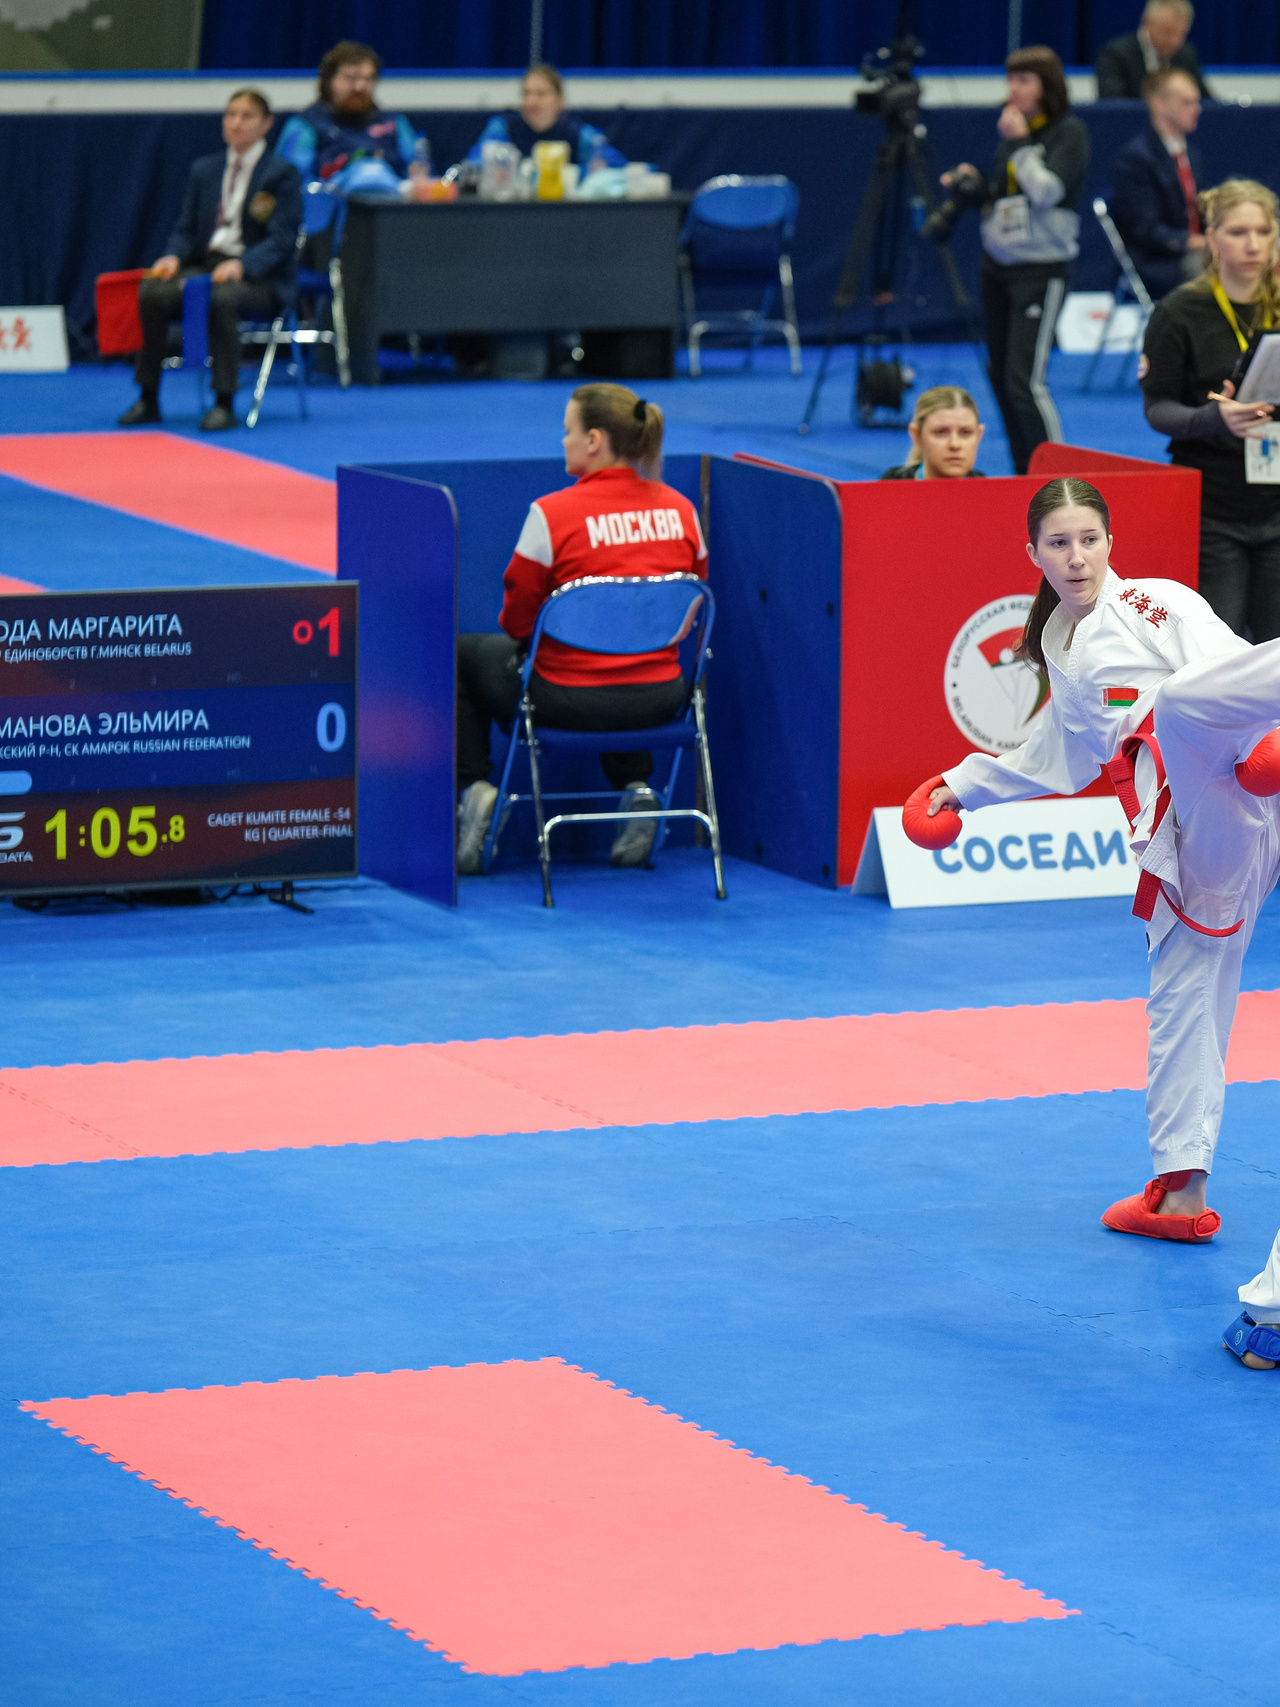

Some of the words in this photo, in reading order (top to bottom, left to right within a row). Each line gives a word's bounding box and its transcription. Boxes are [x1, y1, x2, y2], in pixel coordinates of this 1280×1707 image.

[585, 508, 685, 549] МОСКВА
[50, 613, 183, 640] МАРГАРИТА
[4, 645, 88, 664] ЕДИНОБОРСТВ
[144, 641, 192, 657] BELARUS
[98, 708, 209, 735] ЭЛЬМИРА
[316, 702, 346, 752] 0
[0, 742, 36, 760] СКИЙ
[133, 738, 180, 753] RUSSIAN
[183, 735, 250, 751] FEDERATION
[207, 812, 243, 827] CADET
[246, 810, 287, 825] KUMITE
[289, 808, 330, 823] FEMALE
[244, 828, 260, 842] KG
[268, 824, 353, 842] QUARTER-FINAL
[933, 830, 1127, 874] СОСЕДИ
